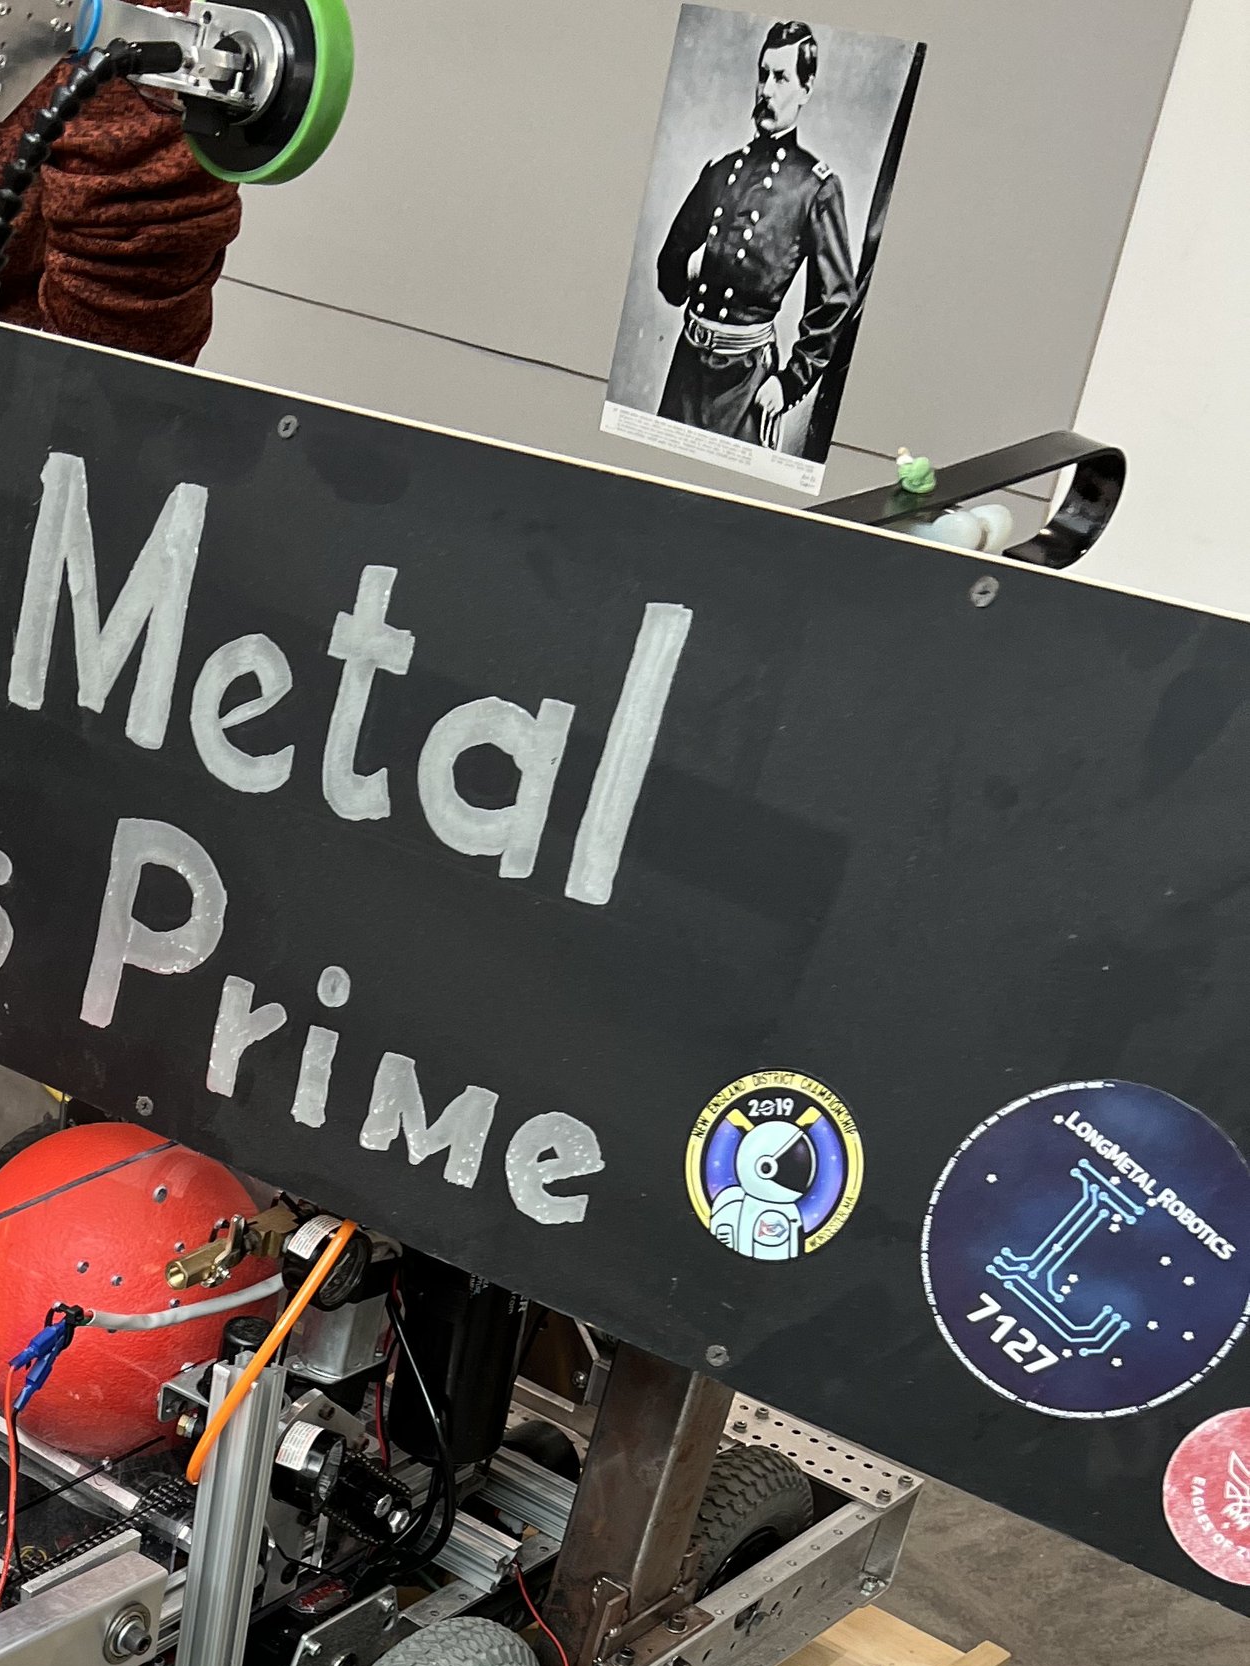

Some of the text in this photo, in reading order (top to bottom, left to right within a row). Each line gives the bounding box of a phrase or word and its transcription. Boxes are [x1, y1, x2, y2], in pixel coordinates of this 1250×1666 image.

[8, 452, 693, 905] Metal
[690, 1073, 858, 1139] NEW ENGLAND DISTRICT CHAMPIONSHIP
[747, 1097, 795, 1118] 2019
[1155, 1187, 1238, 1261] ROBOTICS
[966, 1292, 1060, 1374] 7127
[1191, 1475, 1215, 1533] EAGLES
[1212, 1532, 1235, 1549] OF
